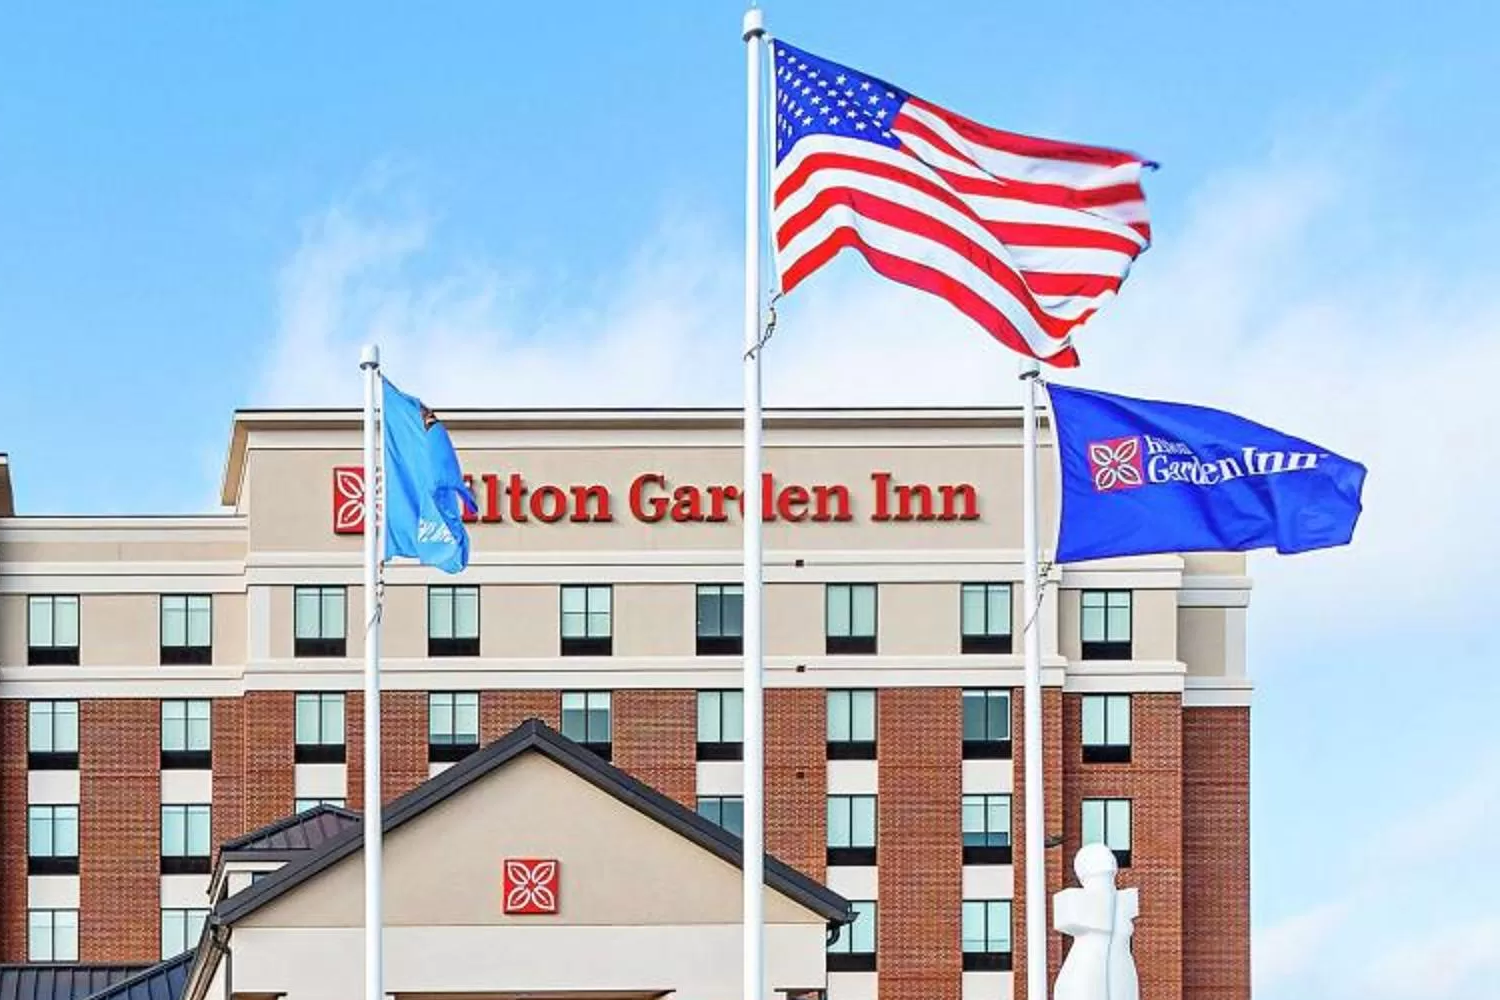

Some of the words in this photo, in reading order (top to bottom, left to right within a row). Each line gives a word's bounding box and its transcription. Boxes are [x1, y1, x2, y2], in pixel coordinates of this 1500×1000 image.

[1243, 447, 1318, 475] Inn
[462, 474, 612, 523] ilton
[871, 473, 980, 521] Inn
